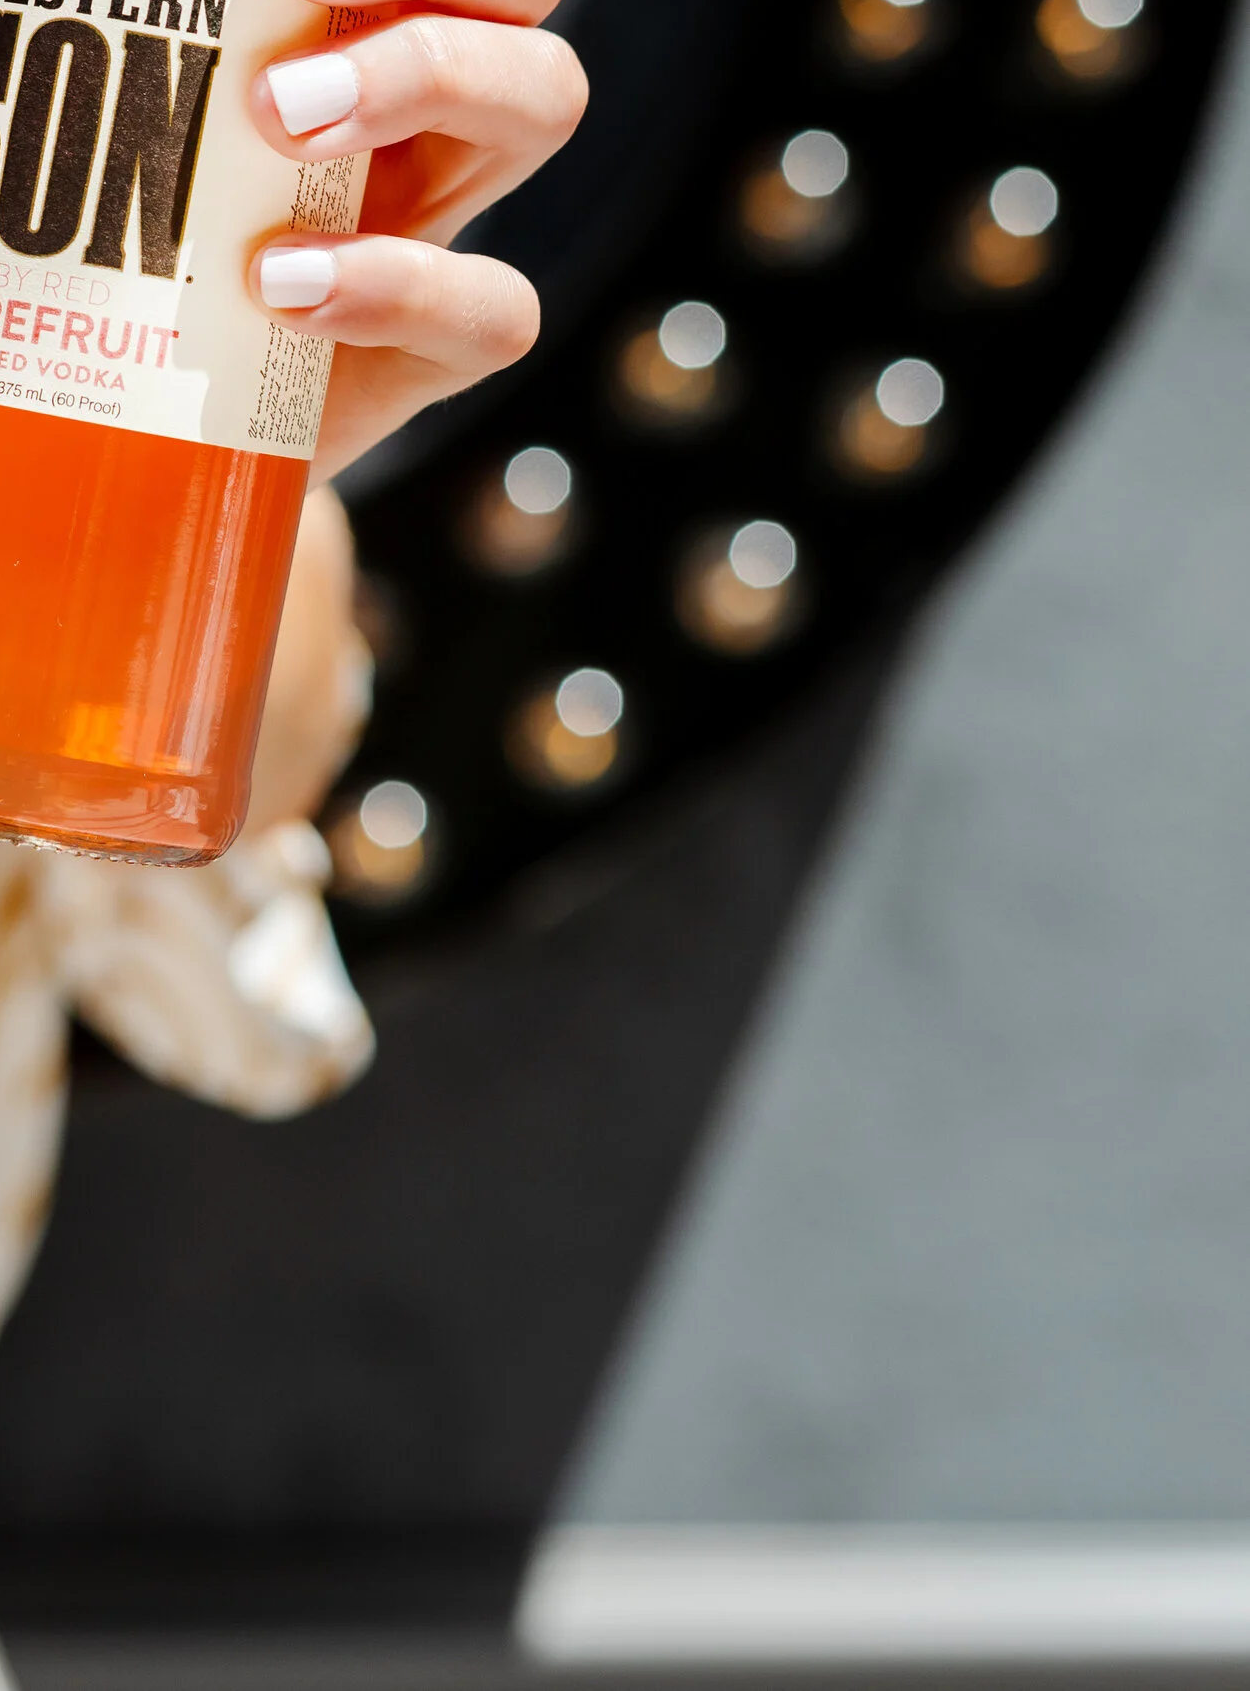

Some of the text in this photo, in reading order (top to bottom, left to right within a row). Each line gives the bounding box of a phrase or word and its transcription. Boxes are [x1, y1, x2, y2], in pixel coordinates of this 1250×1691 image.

[41, 270, 111, 307] RED
[37, 357, 126, 392] VODKA
[25, 386, 48, 403] mL
[50, 390, 75, 409] (60
[78, 395, 122, 419] Proof)
